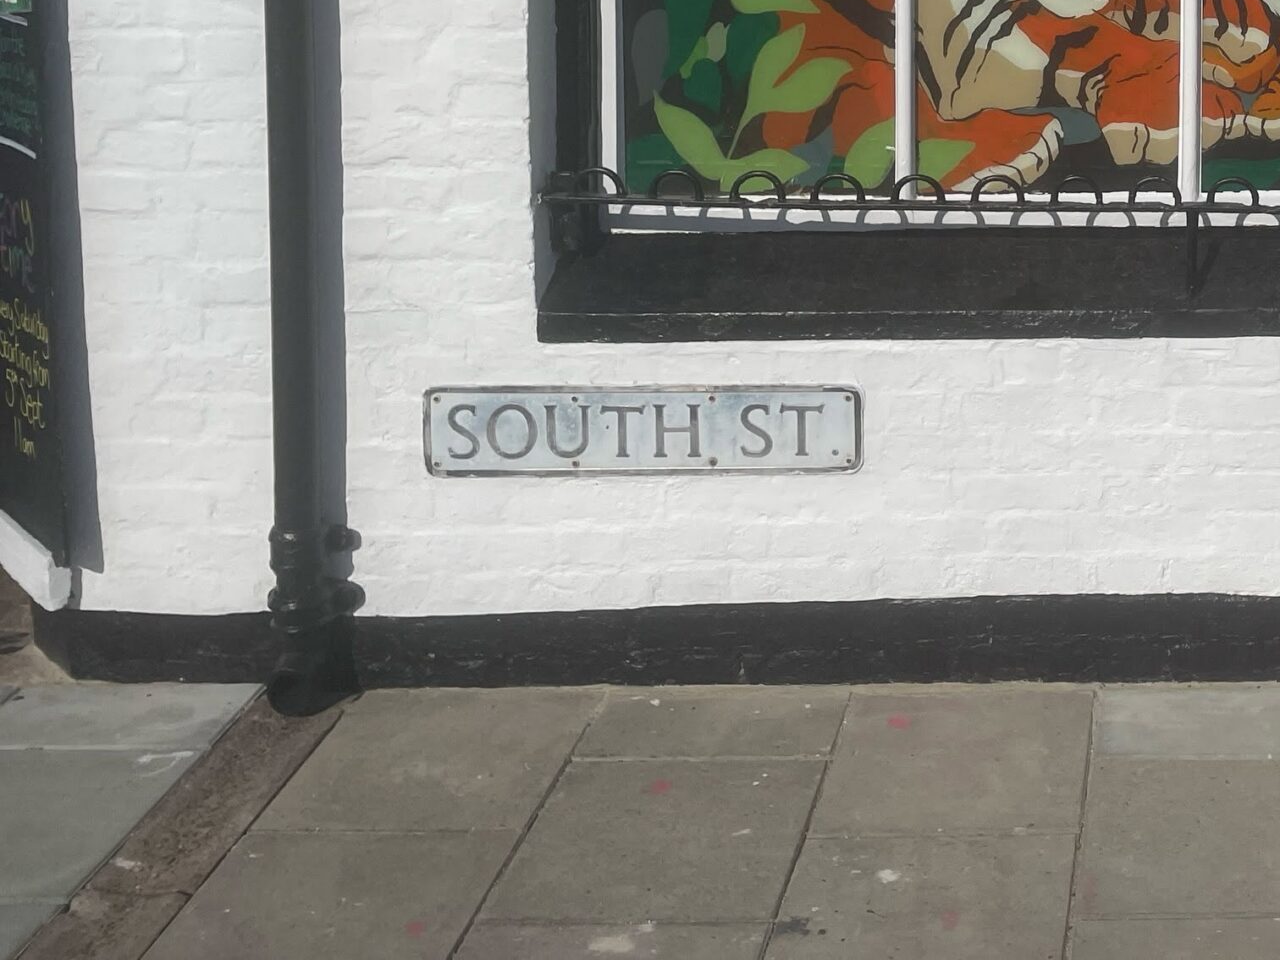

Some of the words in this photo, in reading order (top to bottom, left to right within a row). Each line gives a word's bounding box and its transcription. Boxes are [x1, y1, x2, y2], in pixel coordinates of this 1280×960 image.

[14, 297, 50, 360] Saturday
[32, 350, 50, 391] from
[20, 377, 45, 431] Sept
[14, 416, 36, 460] 11am
[447, 403, 702, 460] SOUTH
